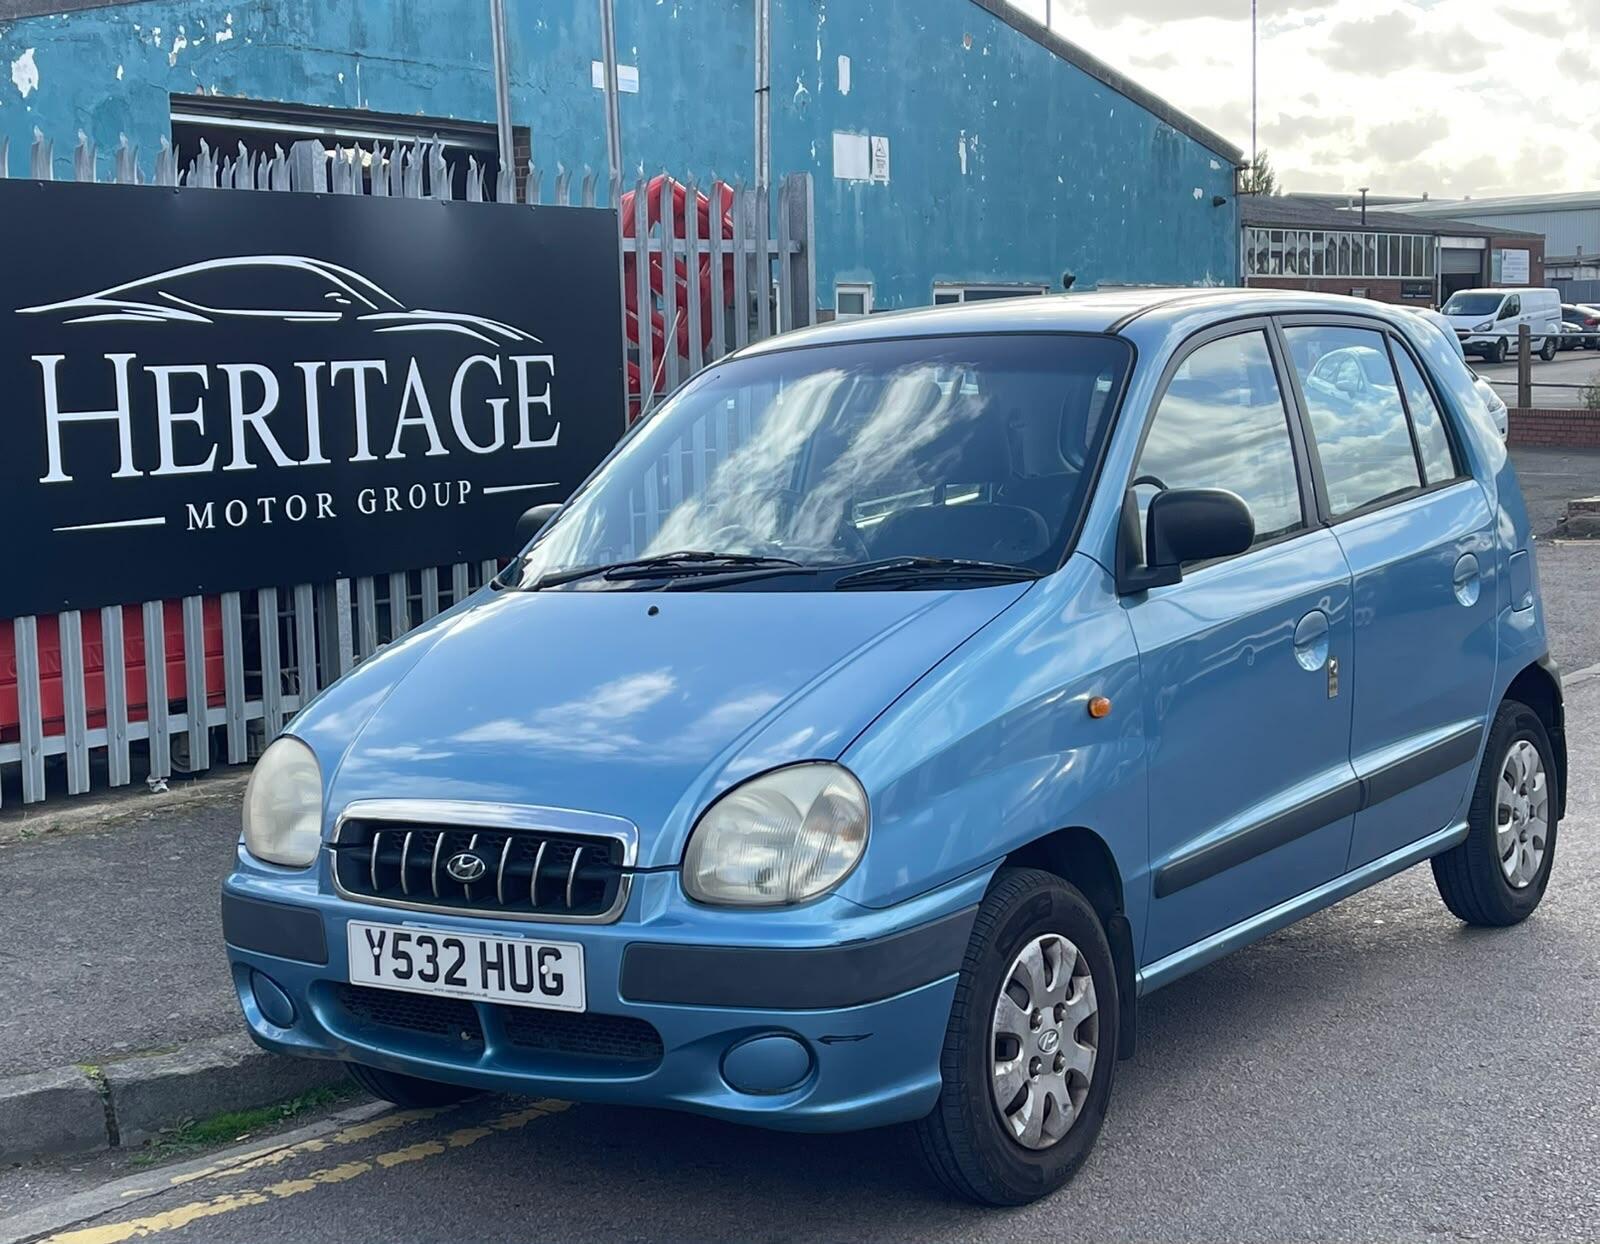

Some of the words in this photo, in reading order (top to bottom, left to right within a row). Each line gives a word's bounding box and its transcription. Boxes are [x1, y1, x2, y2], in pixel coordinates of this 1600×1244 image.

[31, 353, 560, 483] HERITAGE
[186, 493, 336, 530] MOTOR
[357, 480, 472, 514] GROUP
[365, 928, 467, 987] Y532
[479, 941, 565, 996] HUG
